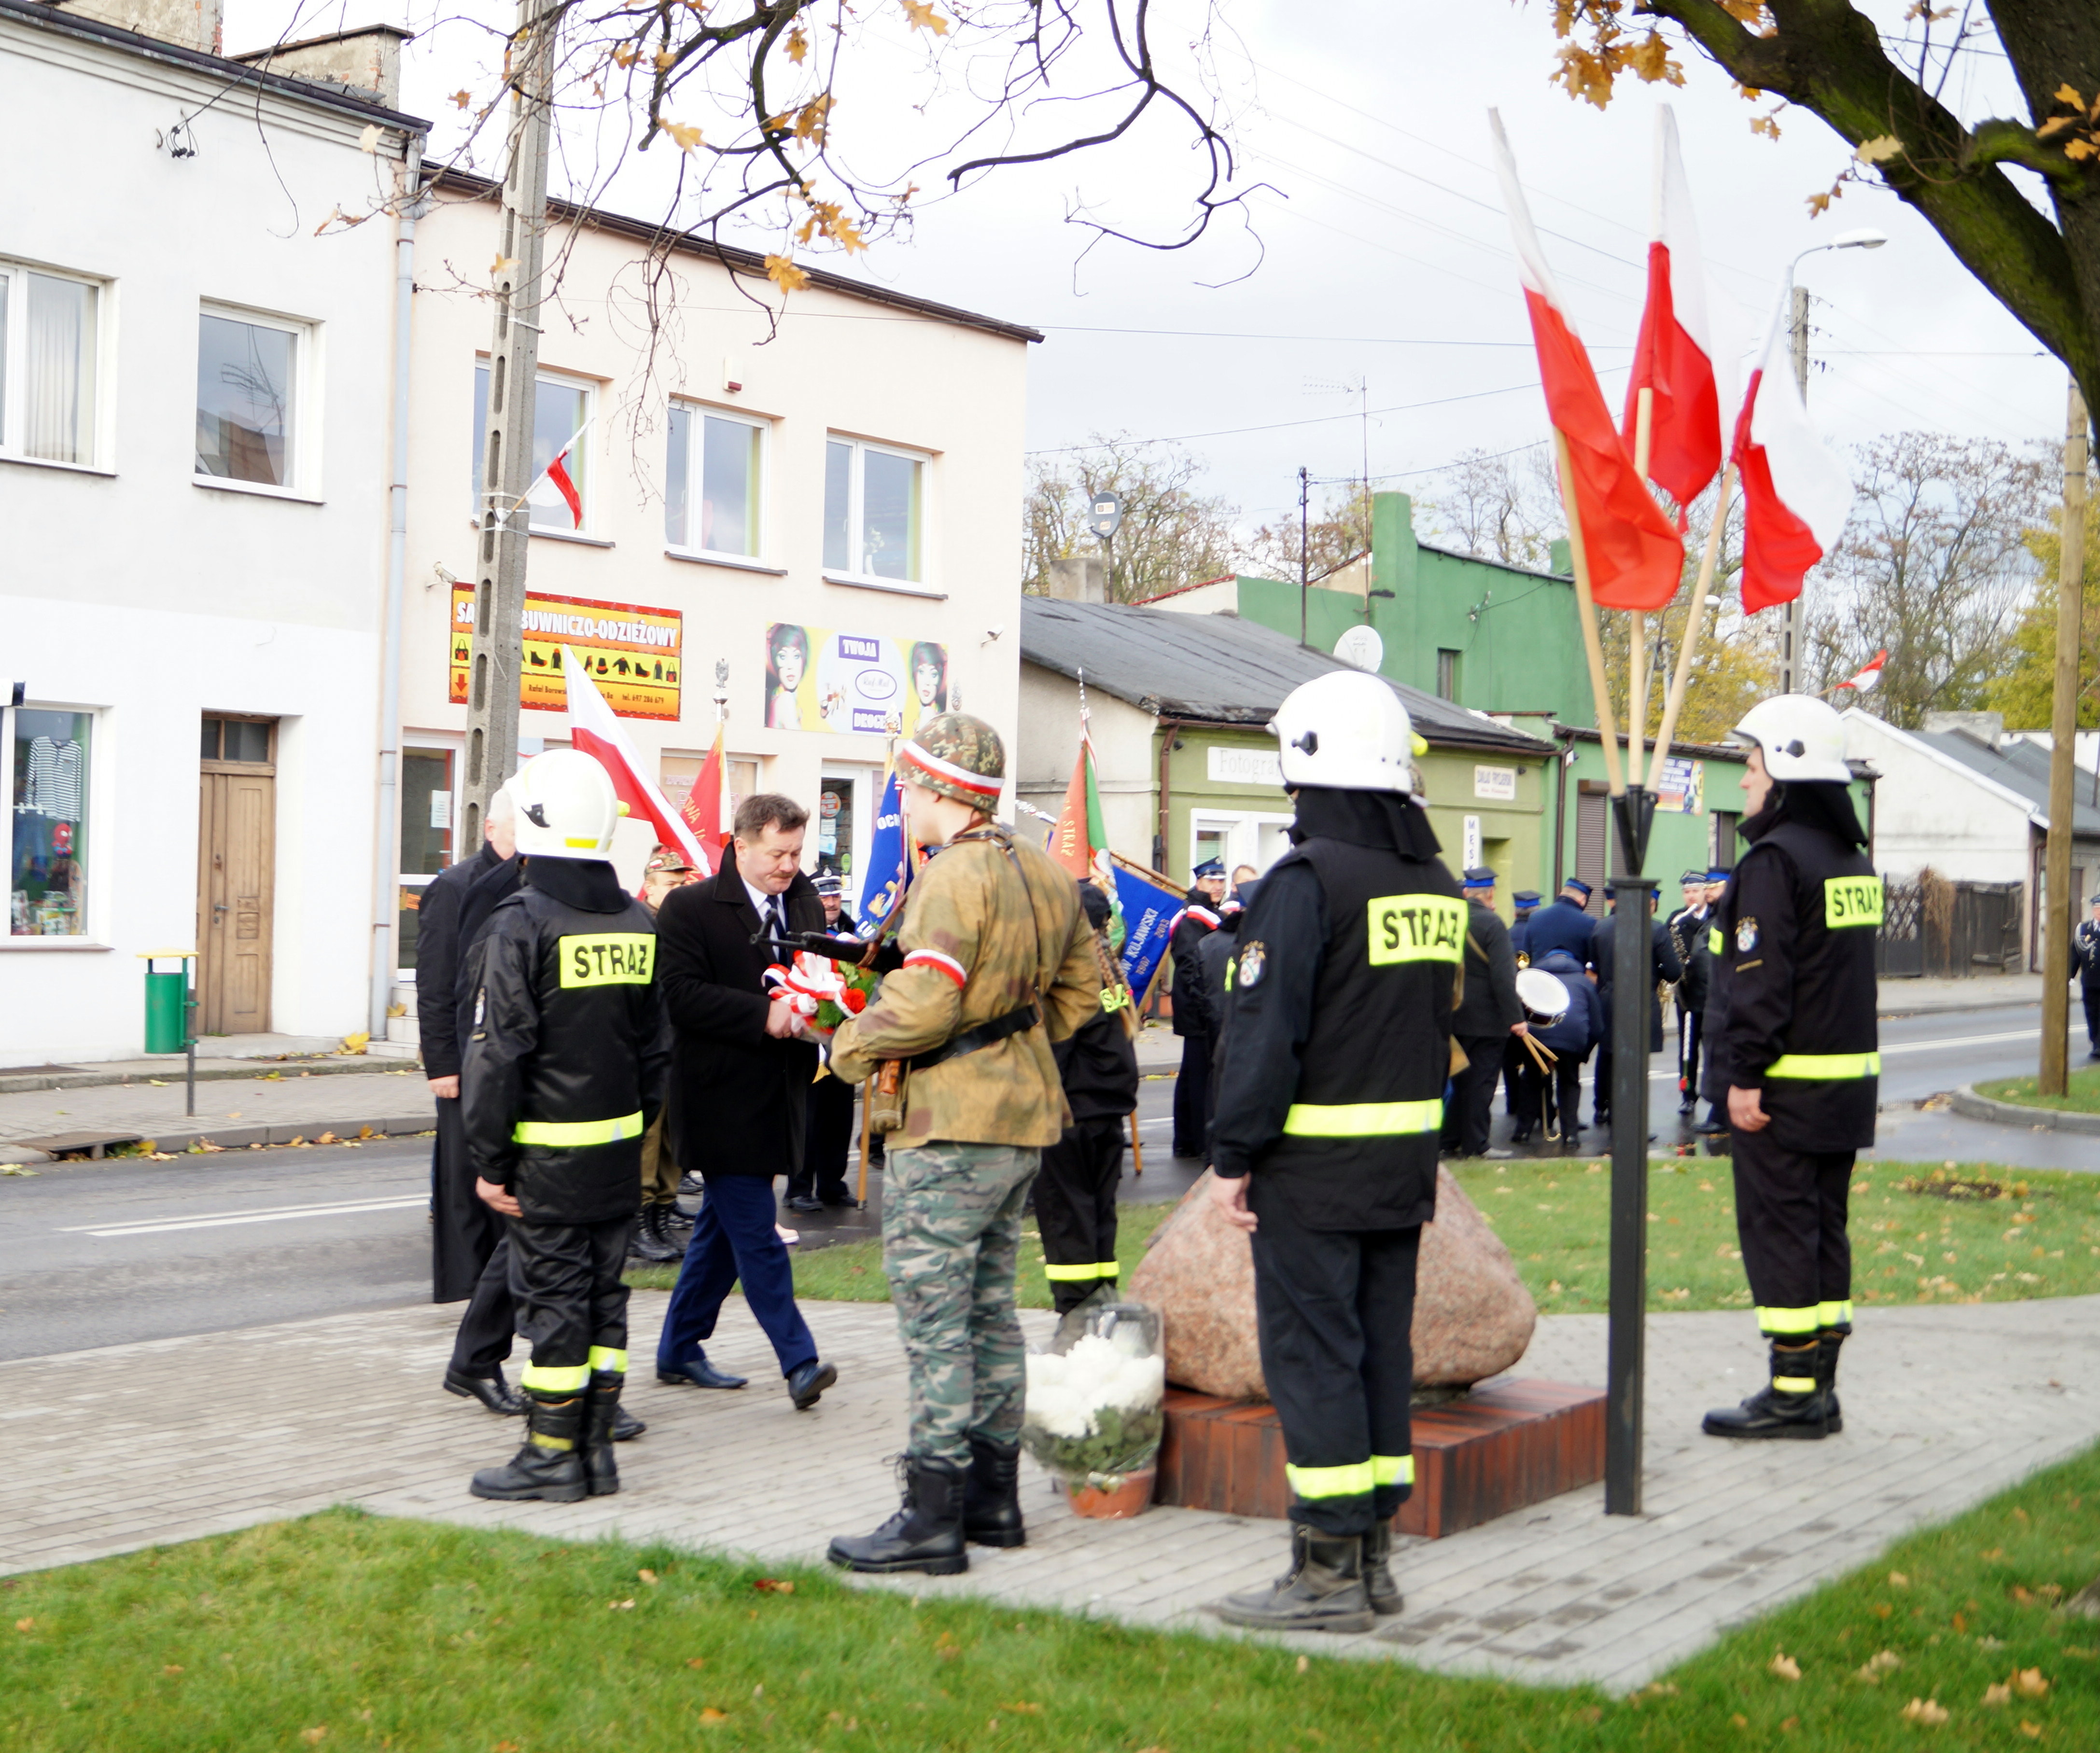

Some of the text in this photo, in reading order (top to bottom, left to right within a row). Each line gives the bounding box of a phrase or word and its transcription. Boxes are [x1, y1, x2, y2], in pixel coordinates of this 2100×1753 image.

[521, 609, 677, 647] BUWNICZO-ODZIEŻOWY
[842, 639, 877, 657] TWOJA
[545, 685, 567, 695] Borowsk
[854, 712, 901, 731] DROGE
[1125, 907, 1159, 959] KUJAWSKI
